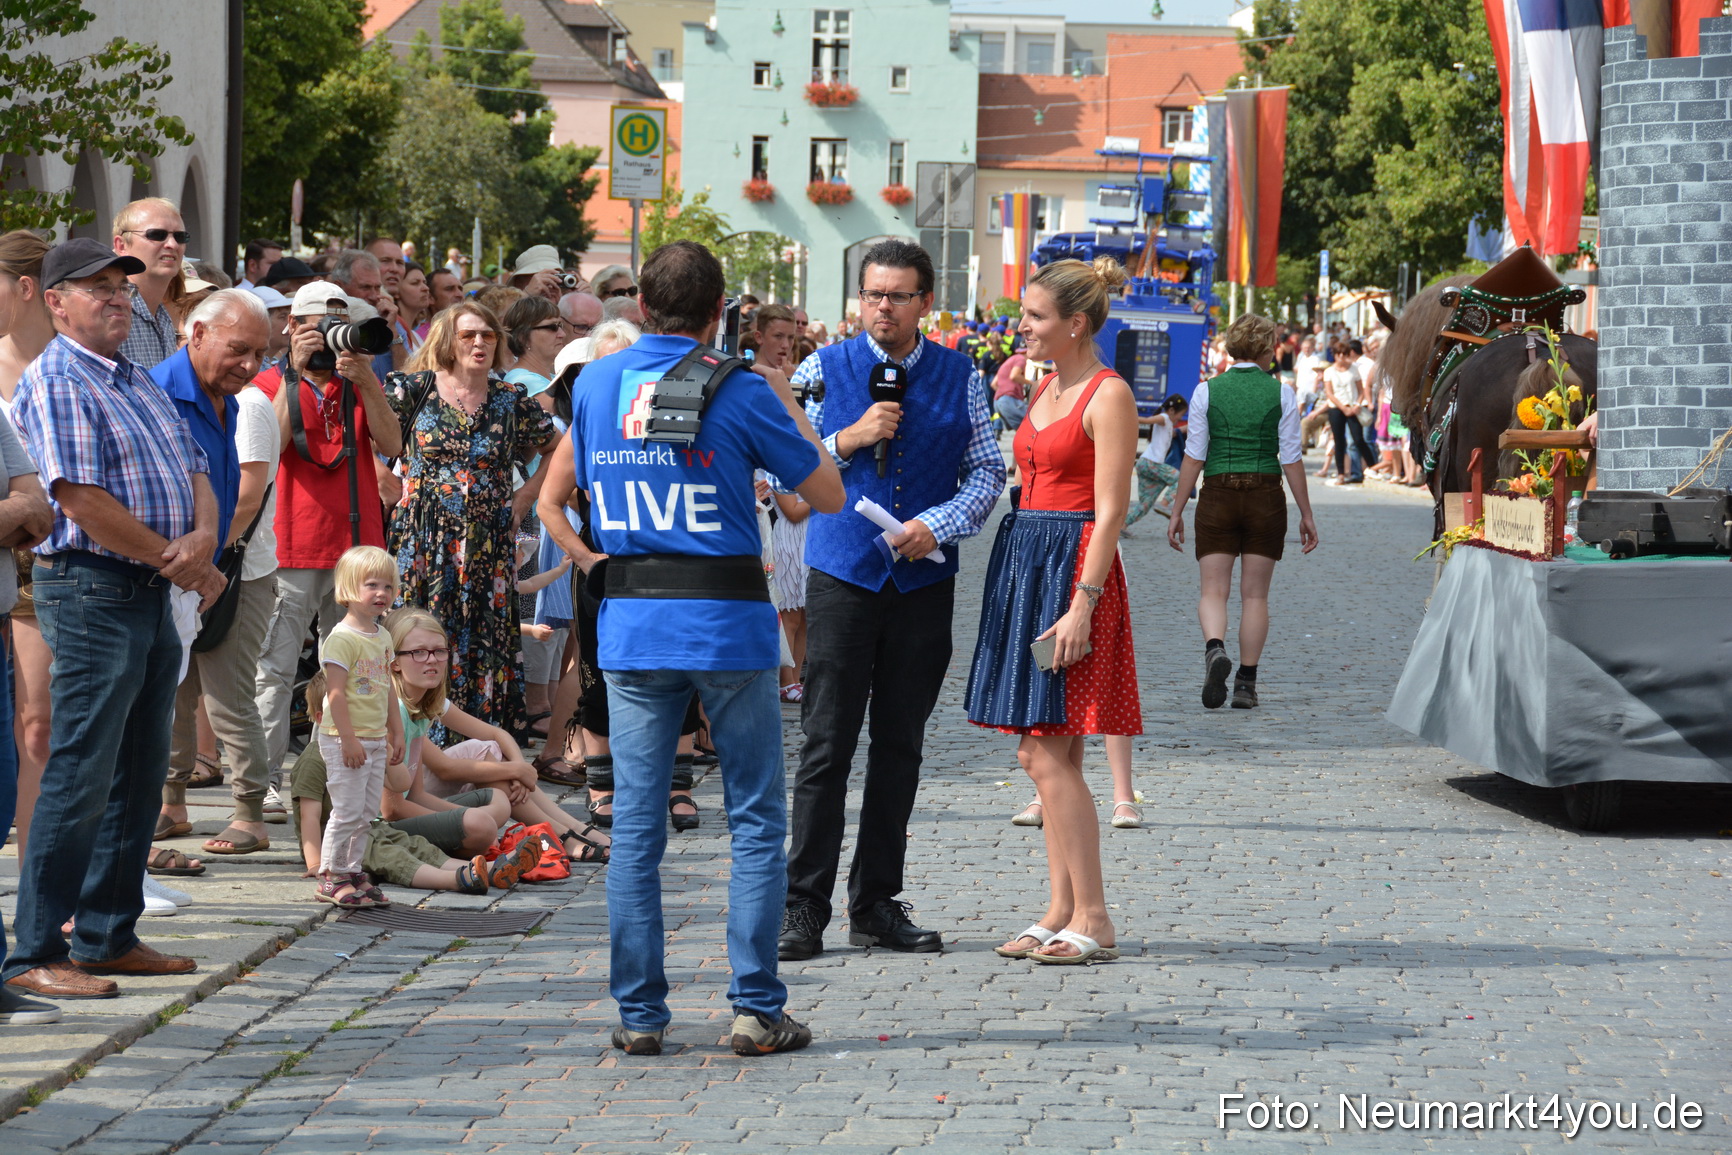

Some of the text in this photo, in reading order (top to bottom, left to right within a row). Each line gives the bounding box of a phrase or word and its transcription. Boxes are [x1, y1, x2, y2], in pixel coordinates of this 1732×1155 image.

[629, 123, 649, 146] H
[623, 160, 651, 168] Rathaus
[681, 448, 715, 468] TV
[592, 481, 722, 532] LIVE
